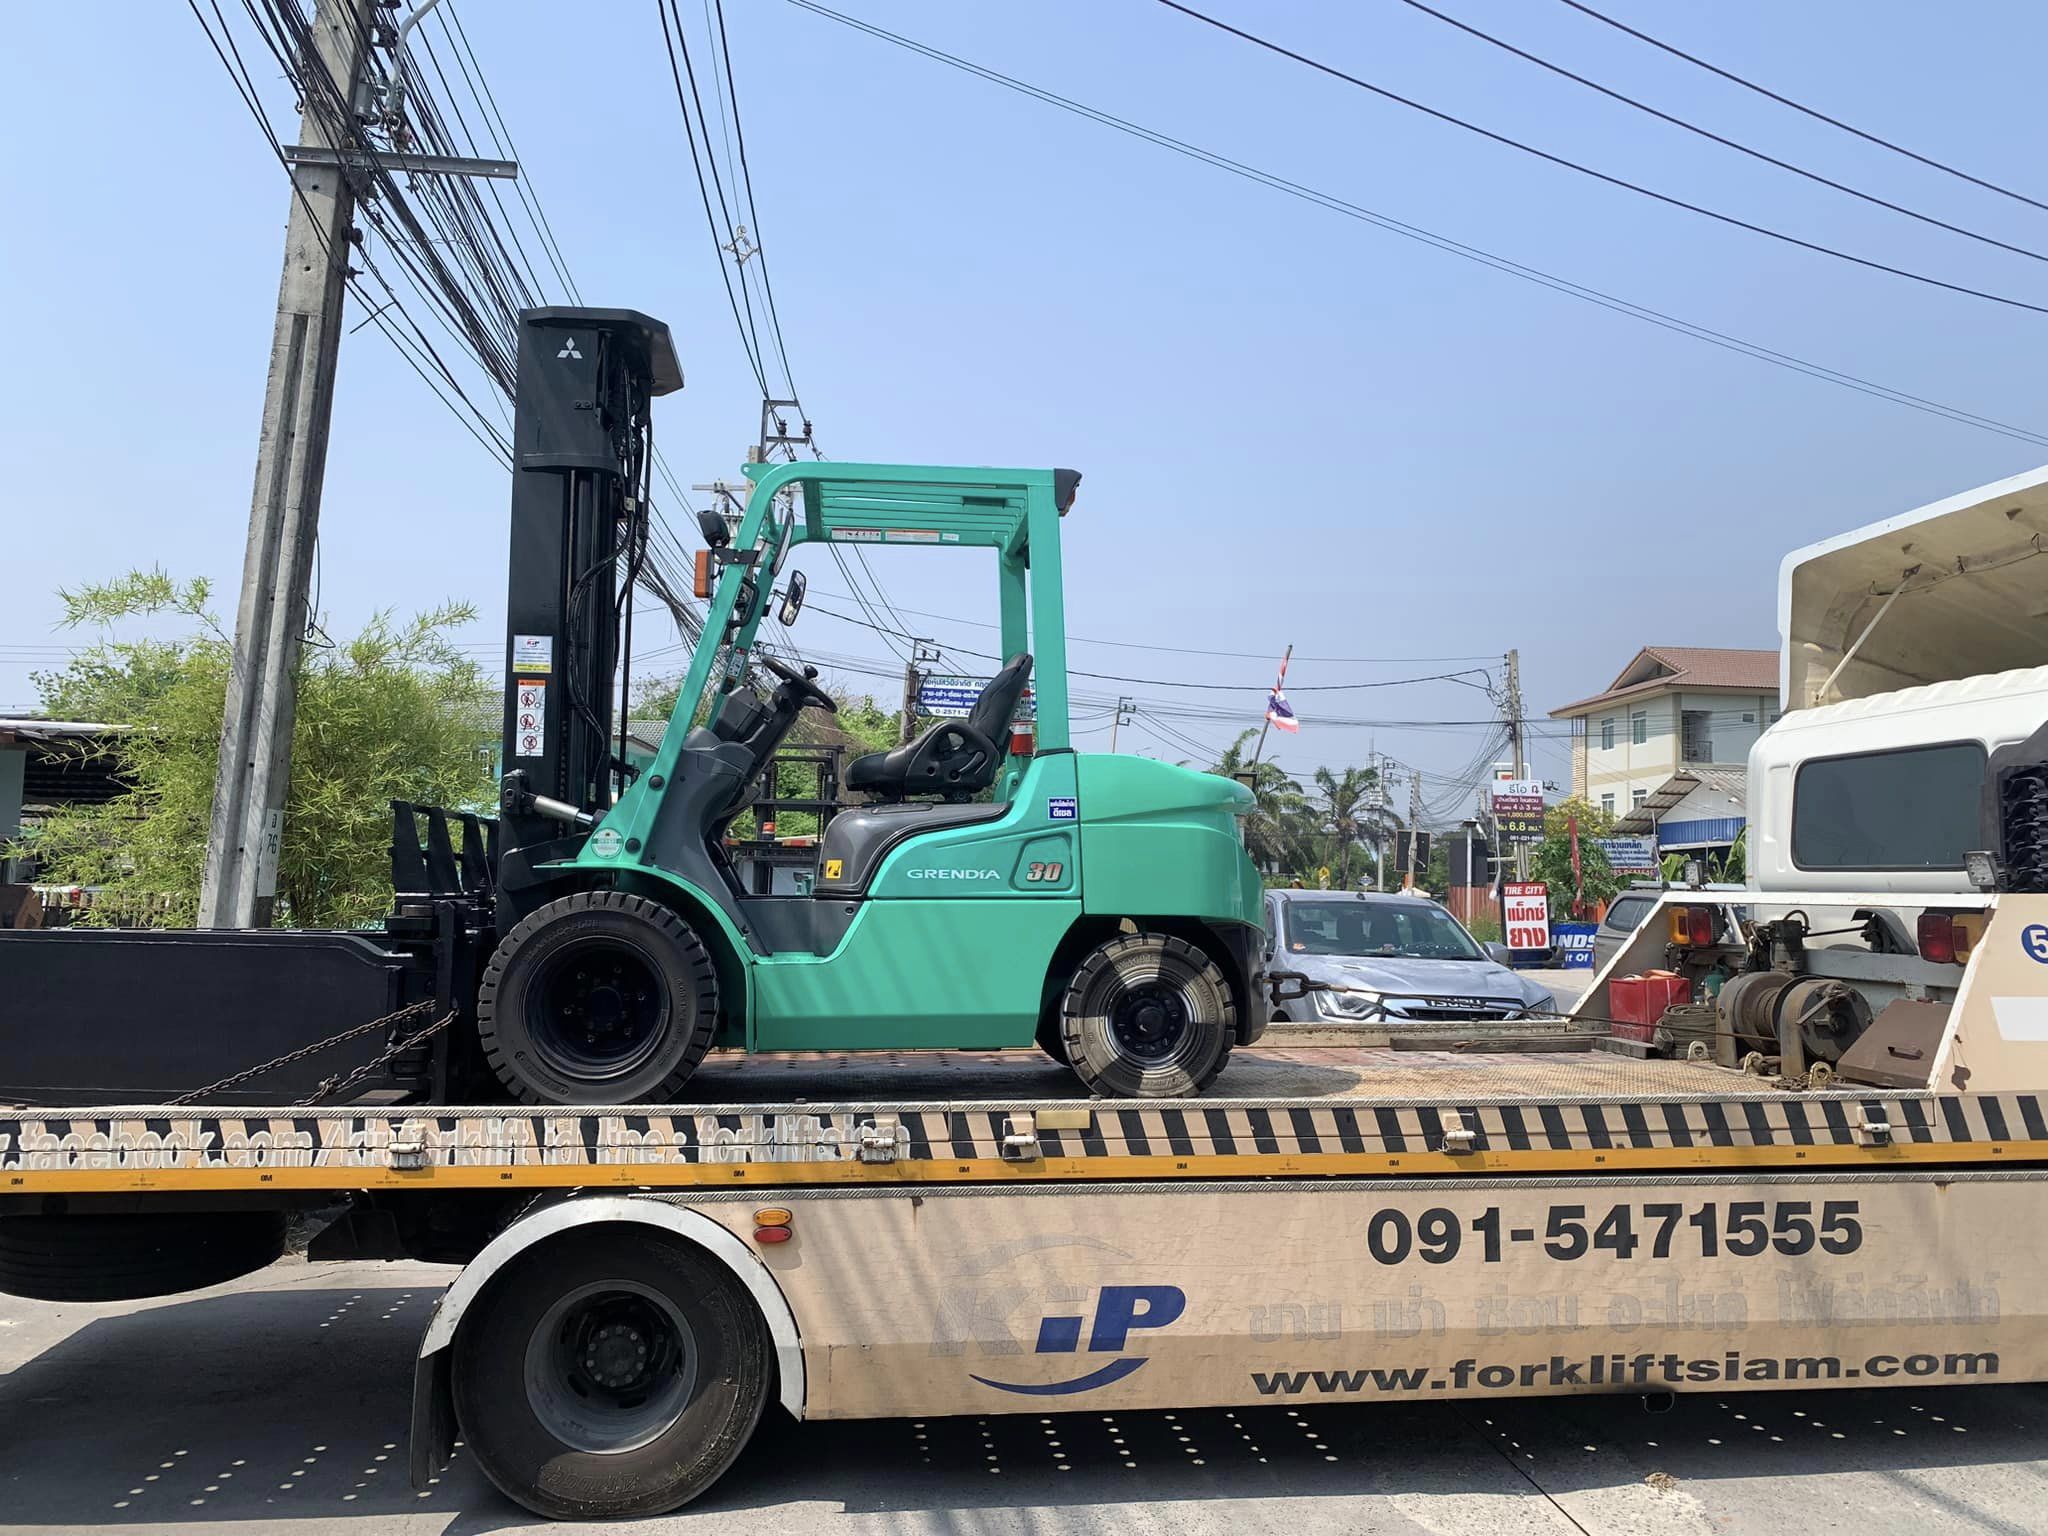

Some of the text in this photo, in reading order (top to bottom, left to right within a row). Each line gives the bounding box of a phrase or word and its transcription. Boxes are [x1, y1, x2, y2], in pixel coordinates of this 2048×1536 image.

[1509, 821, 1526, 831] 6.8
[1026, 862, 1064, 882] 30
[1504, 886, 1545, 895] TIRE CITY
[1509, 928, 1546, 947] ยาง
[1367, 1200, 1863, 1265] 091-5471555
[1250, 1351, 2000, 1396] www.forkliftsiam.com
